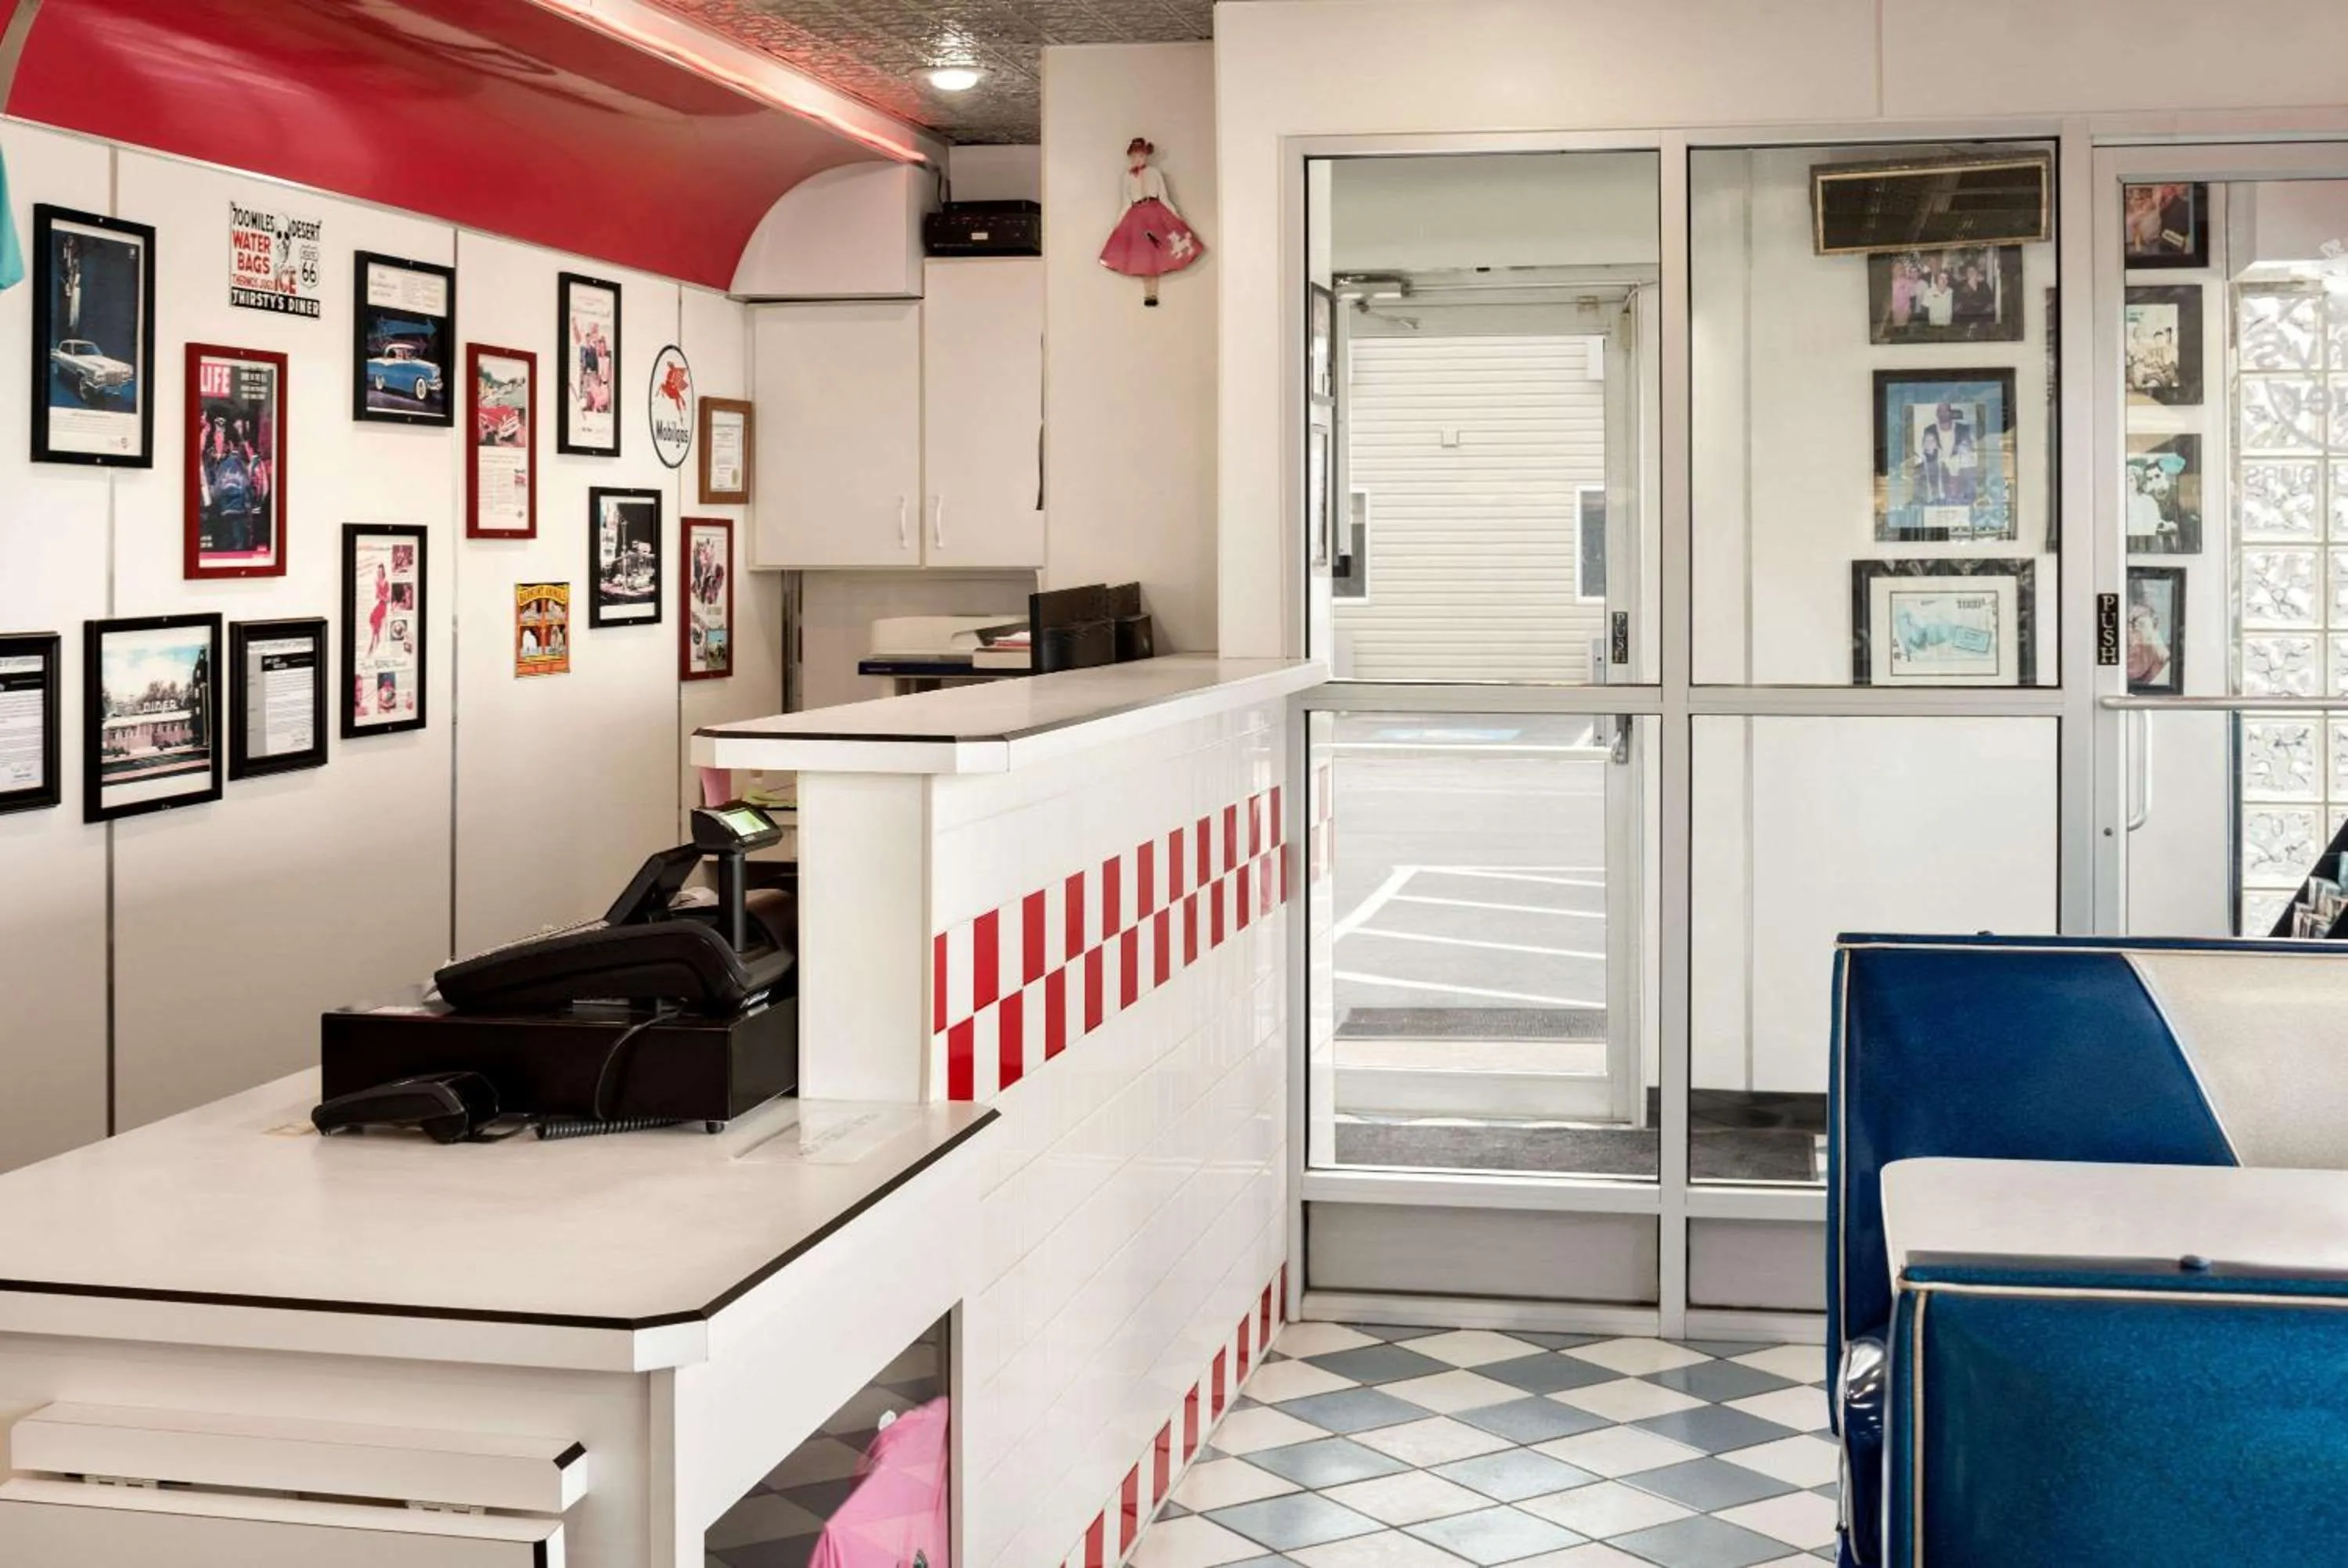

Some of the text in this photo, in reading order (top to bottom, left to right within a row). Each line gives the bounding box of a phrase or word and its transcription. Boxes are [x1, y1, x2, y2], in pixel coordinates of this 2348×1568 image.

[250, 210, 274, 232] MILES
[288, 219, 320, 241] DESERT
[232, 230, 271, 254] WATER
[237, 251, 270, 275] BAGS
[301, 261, 316, 282] 66
[273, 268, 297, 294] ICE
[232, 289, 319, 316] THIRSTY'S DINER
[200, 365, 231, 394] LIFE
[655, 419, 690, 448] Mobilgas
[2101, 595, 2117, 664] PUSH
